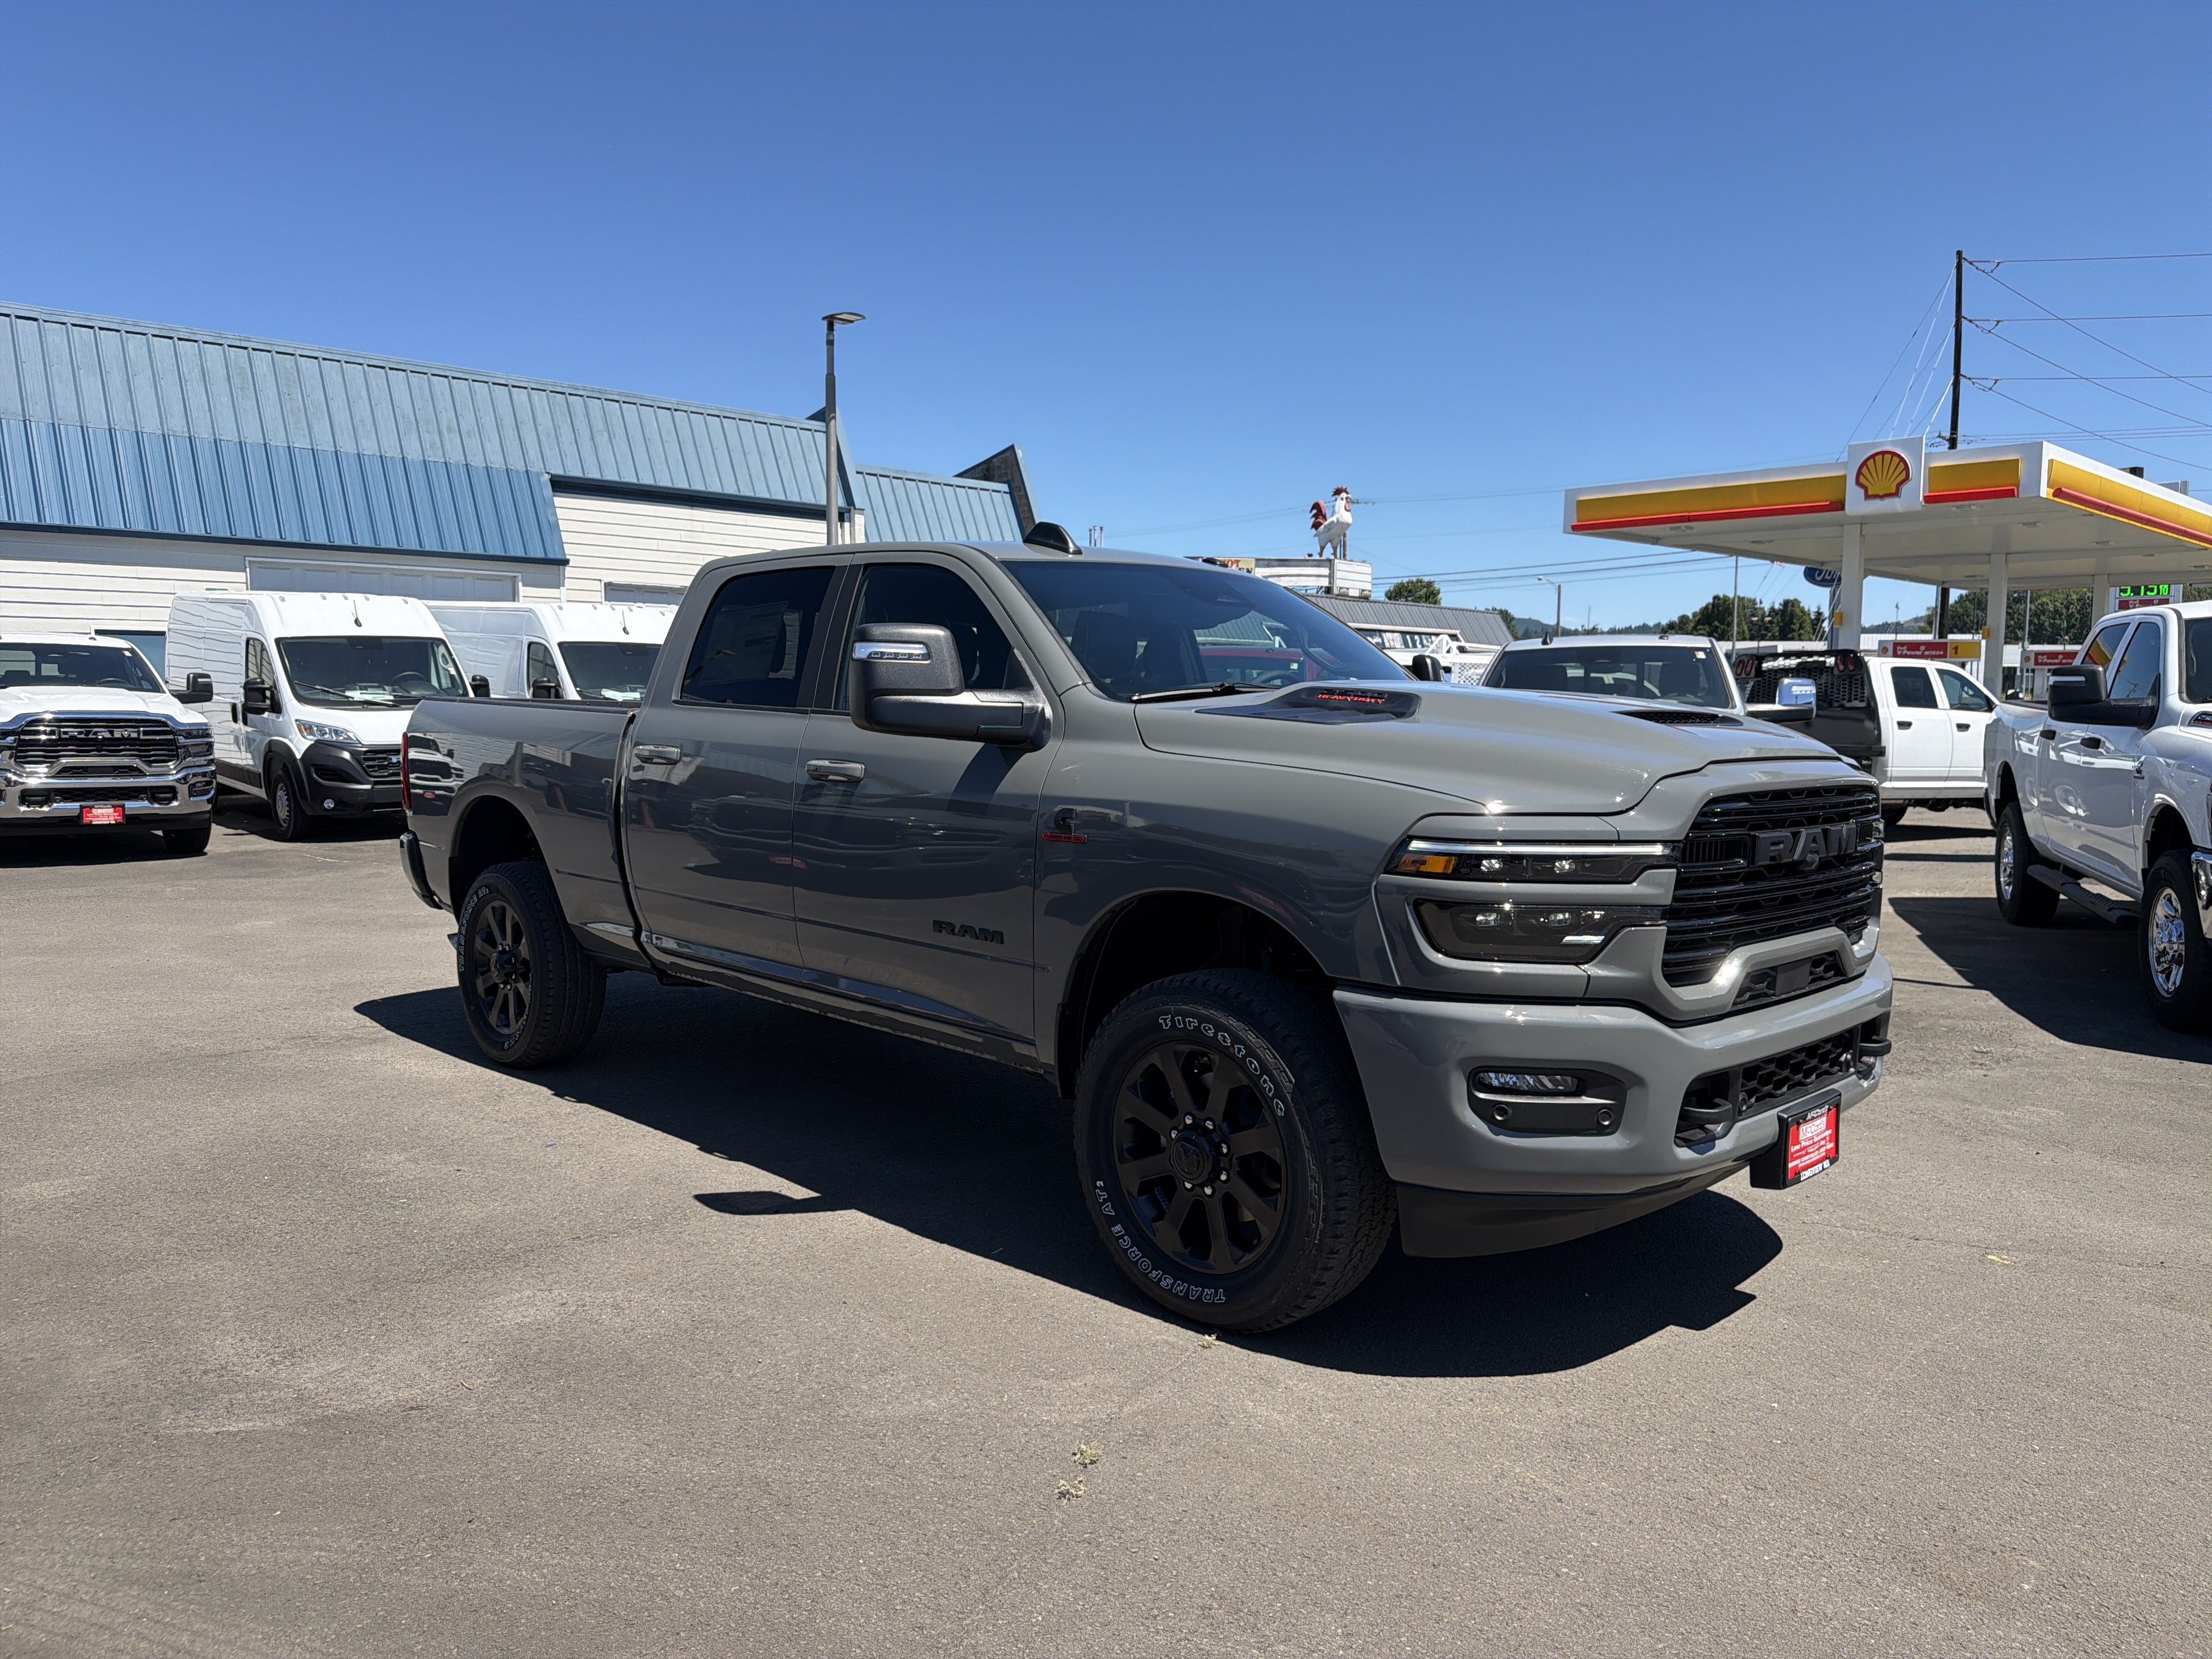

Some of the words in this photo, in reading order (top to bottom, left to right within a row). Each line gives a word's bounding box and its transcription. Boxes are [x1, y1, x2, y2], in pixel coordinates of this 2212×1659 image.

[1952, 645, 1959, 656] 1
[61, 727, 140, 739] RAM
[1755, 824, 1858, 866] RAM
[459, 897, 478, 972] TRANSFORCE
[933, 919, 1005, 945] RAM
[1159, 1014, 1285, 1117] Firestone
[1801, 1120, 1825, 1138] McCord's
[1791, 1144, 1801, 1152] Low
[1801, 1139, 1813, 1148] Price
[1800, 1163, 1822, 1181] LONGVIEW
[1095, 1180, 1116, 1216] AT2
[1111, 1224, 1226, 1304] TRANSFORCE
